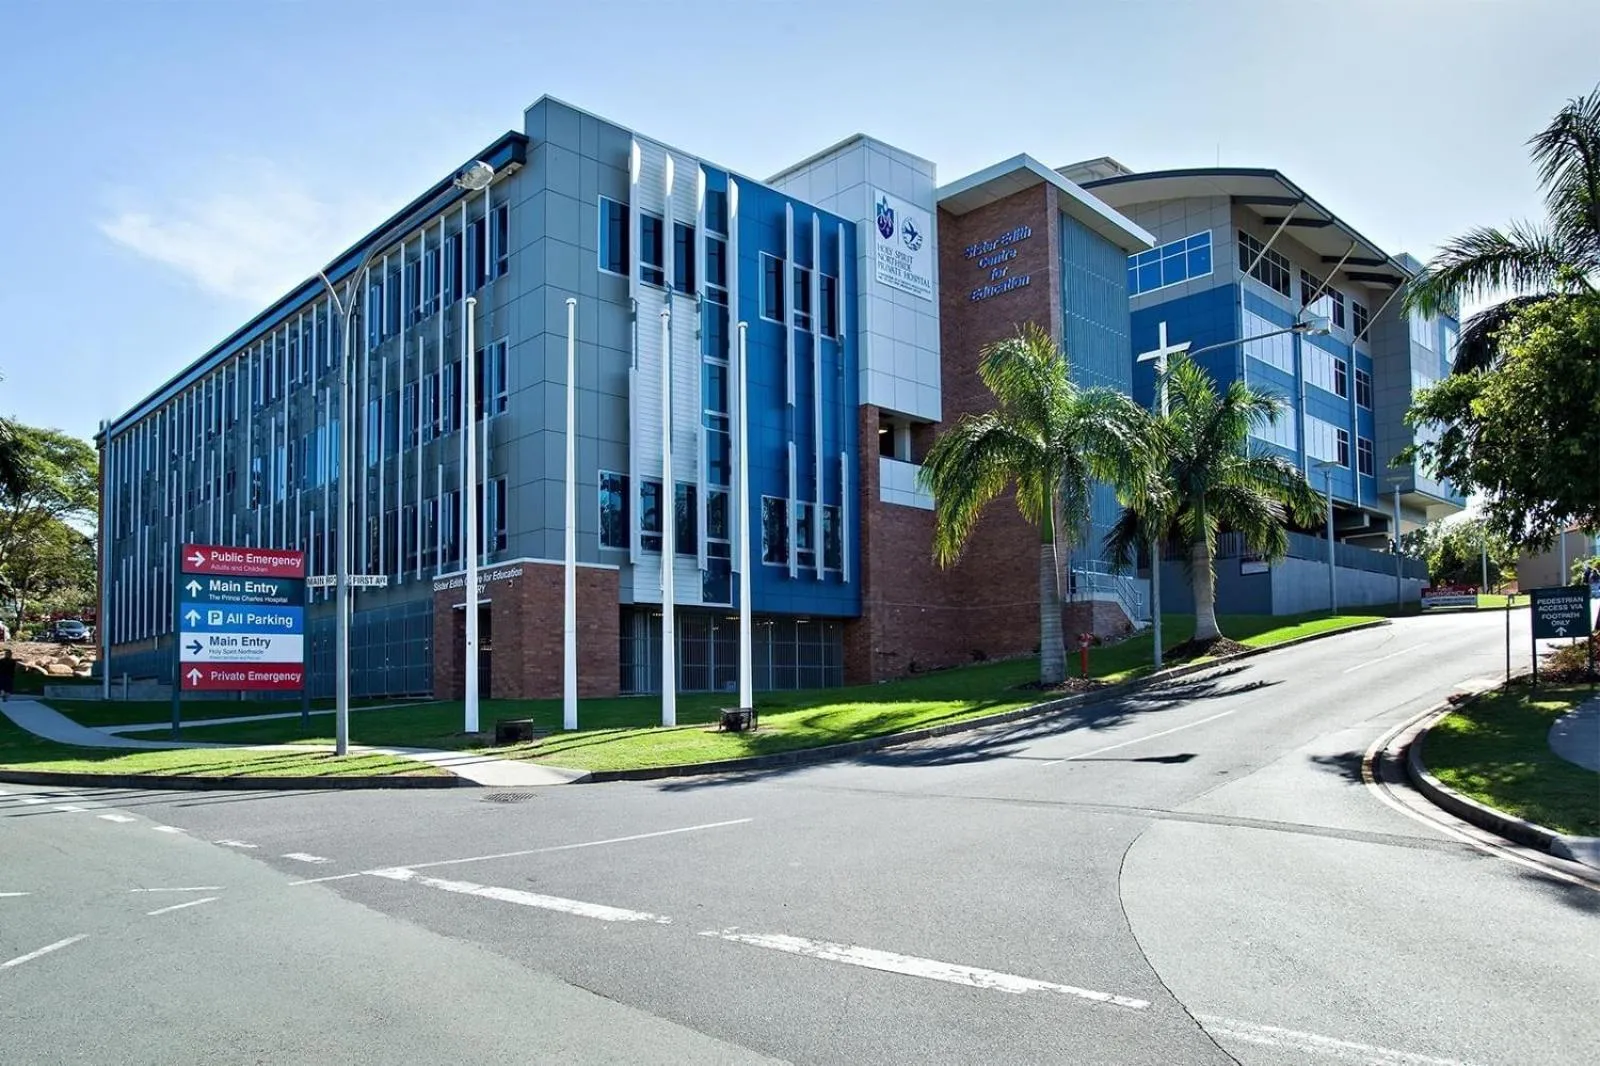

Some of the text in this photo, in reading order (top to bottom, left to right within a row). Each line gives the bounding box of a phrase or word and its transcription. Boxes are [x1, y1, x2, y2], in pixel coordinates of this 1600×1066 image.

[903, 270, 931, 288] HOSPITAL
[990, 266, 1009, 281] for
[970, 275, 1030, 301] Education
[210, 551, 301, 568] Public Emergency
[353, 576, 374, 585] FIRST
[433, 581, 451, 592] Sister
[483, 571, 493, 582] for
[492, 567, 523, 581] Education
[209, 580, 278, 596] Main Entry
[1536, 596, 1584, 605] PEDESTRIAN
[226, 613, 243, 625] All
[246, 614, 293, 628] Parking
[1541, 612, 1580, 620] FOOTPATH
[209, 636, 271, 649] Main Entry
[210, 671, 301, 683] Private Emergency
